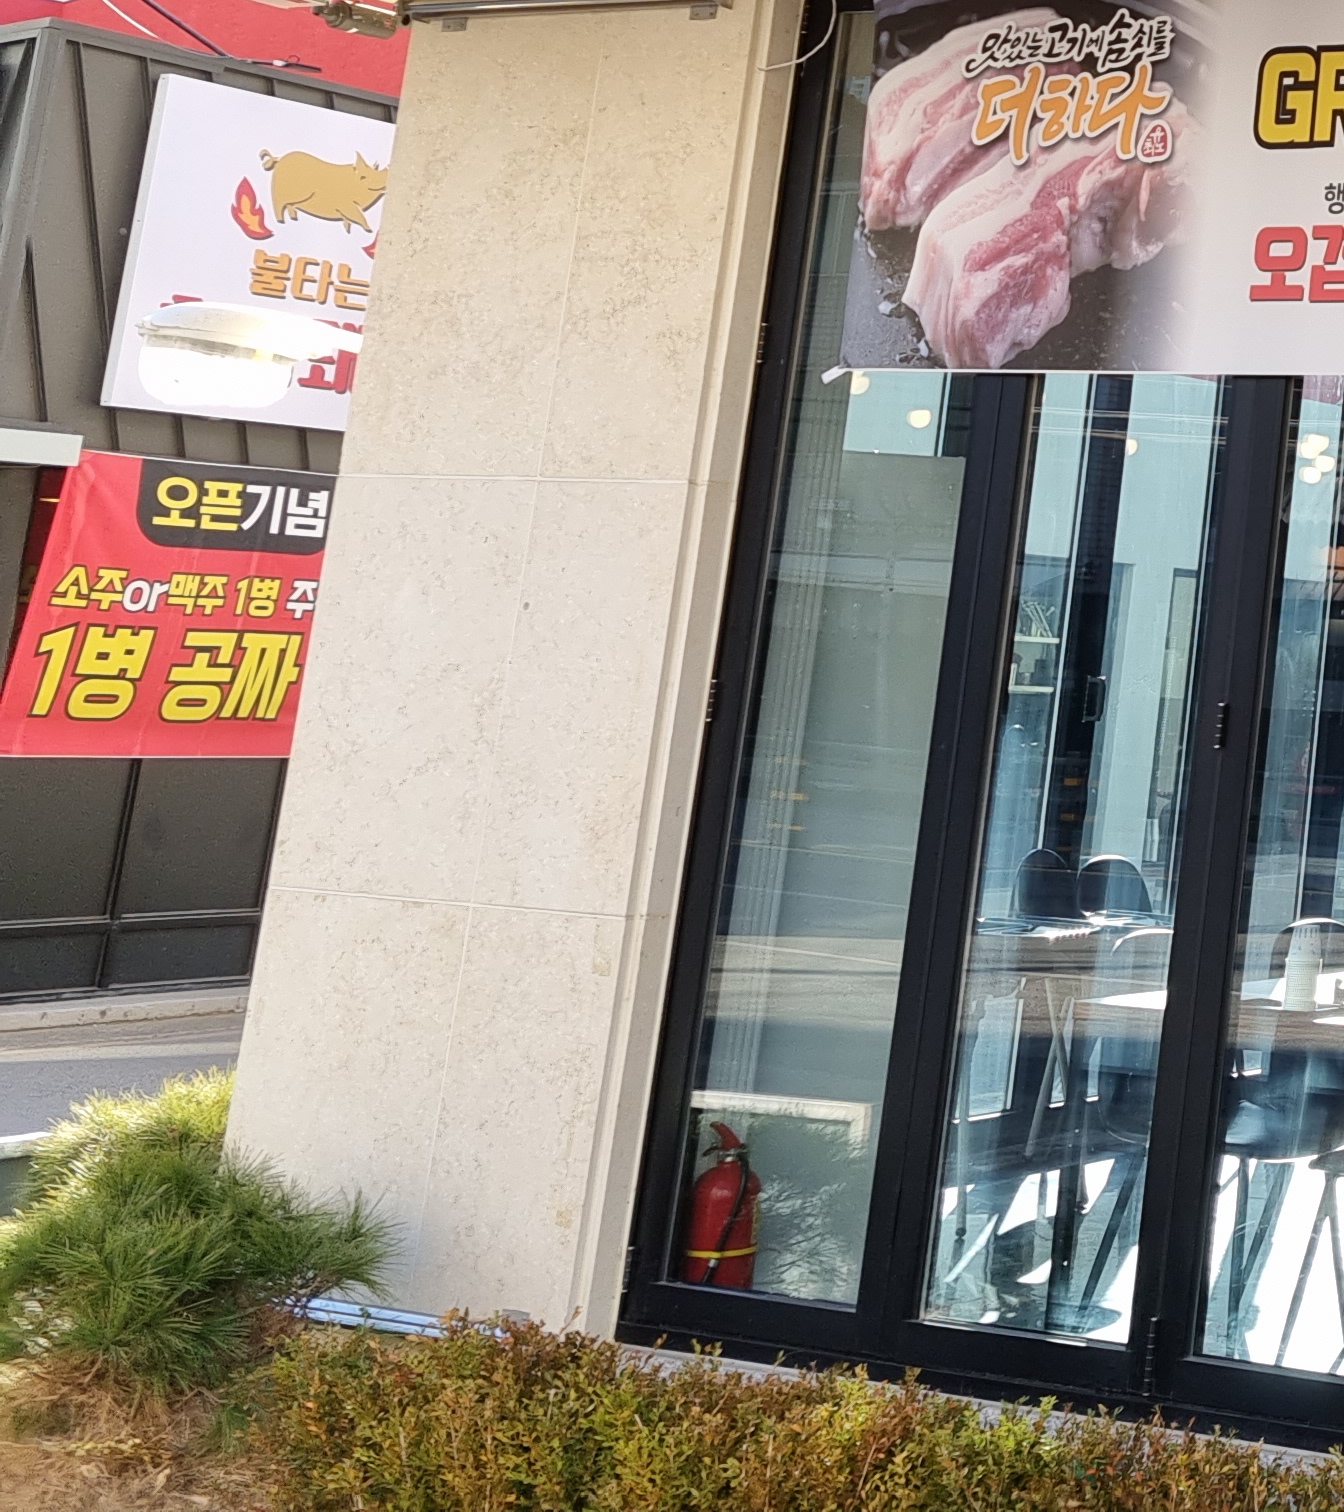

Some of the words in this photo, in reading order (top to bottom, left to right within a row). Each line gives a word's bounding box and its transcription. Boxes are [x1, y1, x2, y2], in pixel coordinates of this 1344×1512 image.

[975, 64, 1168, 161] 더하다
[249, 248, 370, 311] 불타는
[152, 476, 330, 538] 오픈기념
[48, 564, 229, 616] 소주or맥주
[233, 575, 282, 618] 1병
[27, 621, 159, 722] 1병
[159, 628, 304, 723] 공짜
